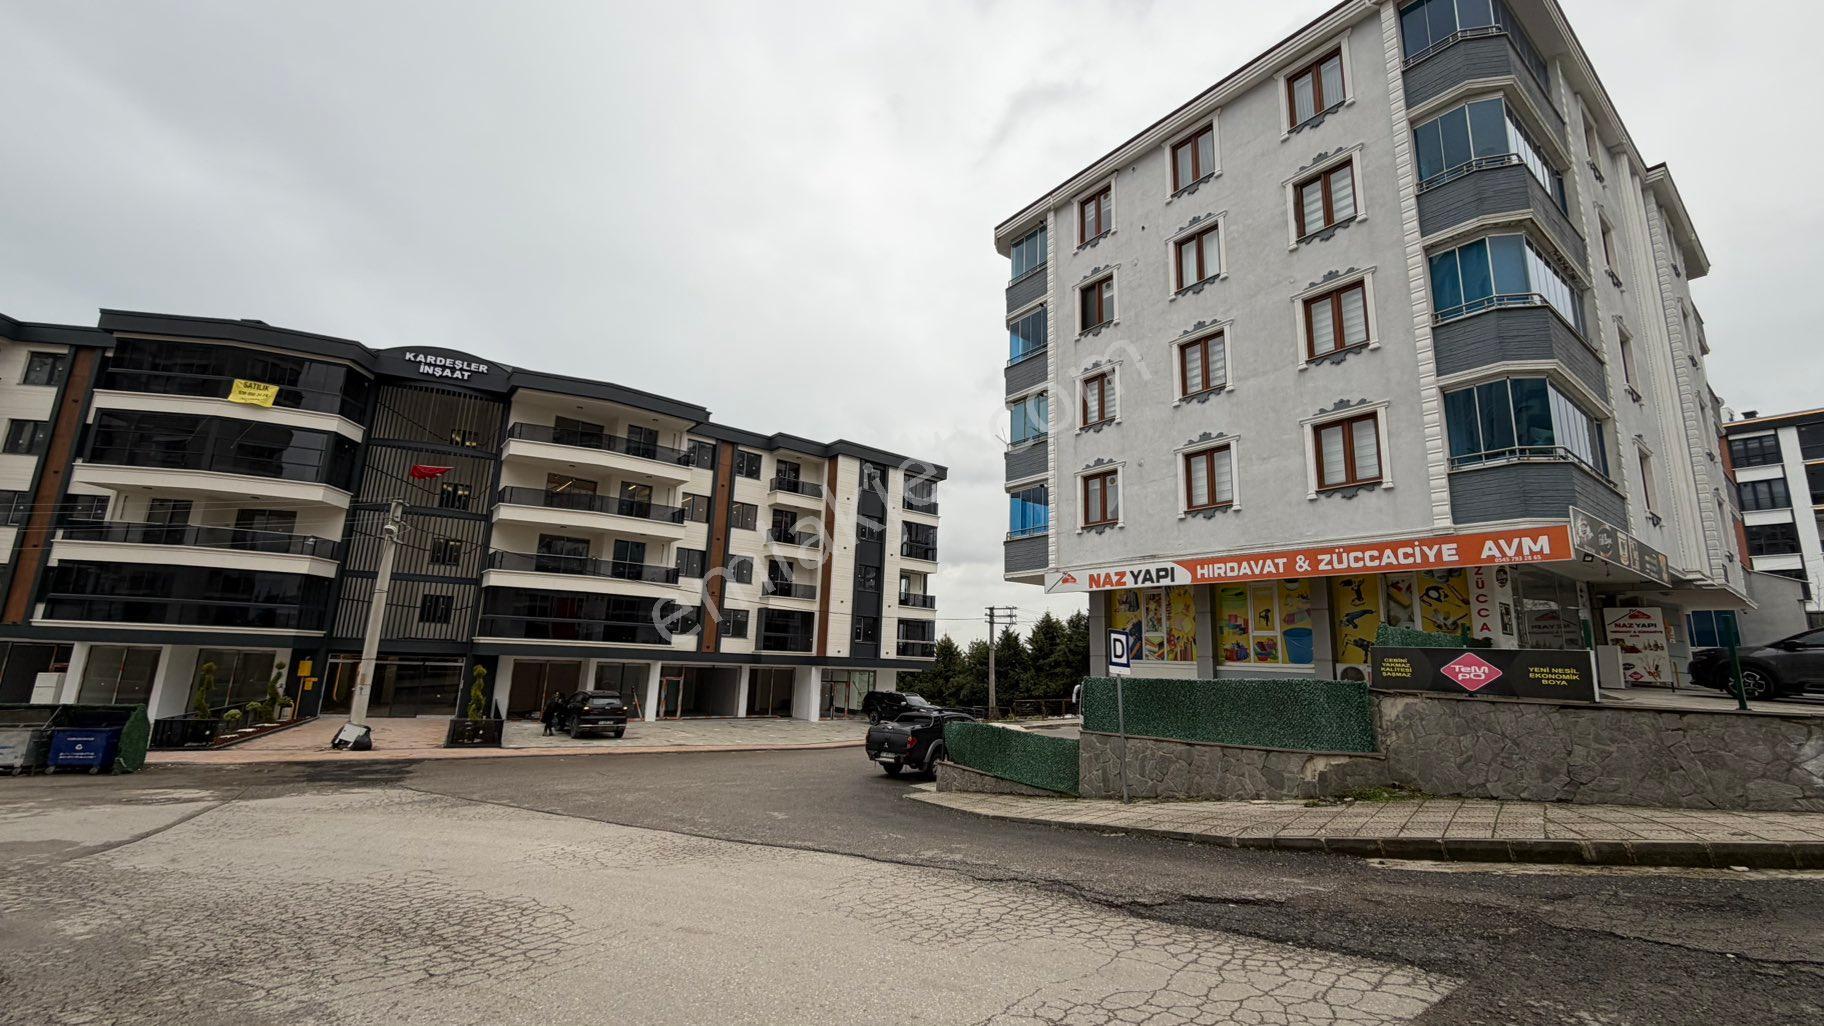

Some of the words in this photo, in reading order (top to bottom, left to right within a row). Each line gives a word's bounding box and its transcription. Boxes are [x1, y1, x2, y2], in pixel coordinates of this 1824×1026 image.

[405, 352, 488, 374] KARDEŞLER
[419, 363, 471, 380] İNŞAAT
[1088, 571, 1127, 589] NAZ
[1130, 567, 1175, 585] YAPI
[1196, 558, 1287, 579] HIRDAVAT
[1295, 554, 1311, 572] &
[1318, 541, 1459, 571] ZÜCCACİYE
[1480, 535, 1550, 559] AVM
[1474, 566, 1493, 640] ZÜCCA
[1113, 638, 1125, 658] D
[1529, 673, 1580, 681] EKONOMİK
